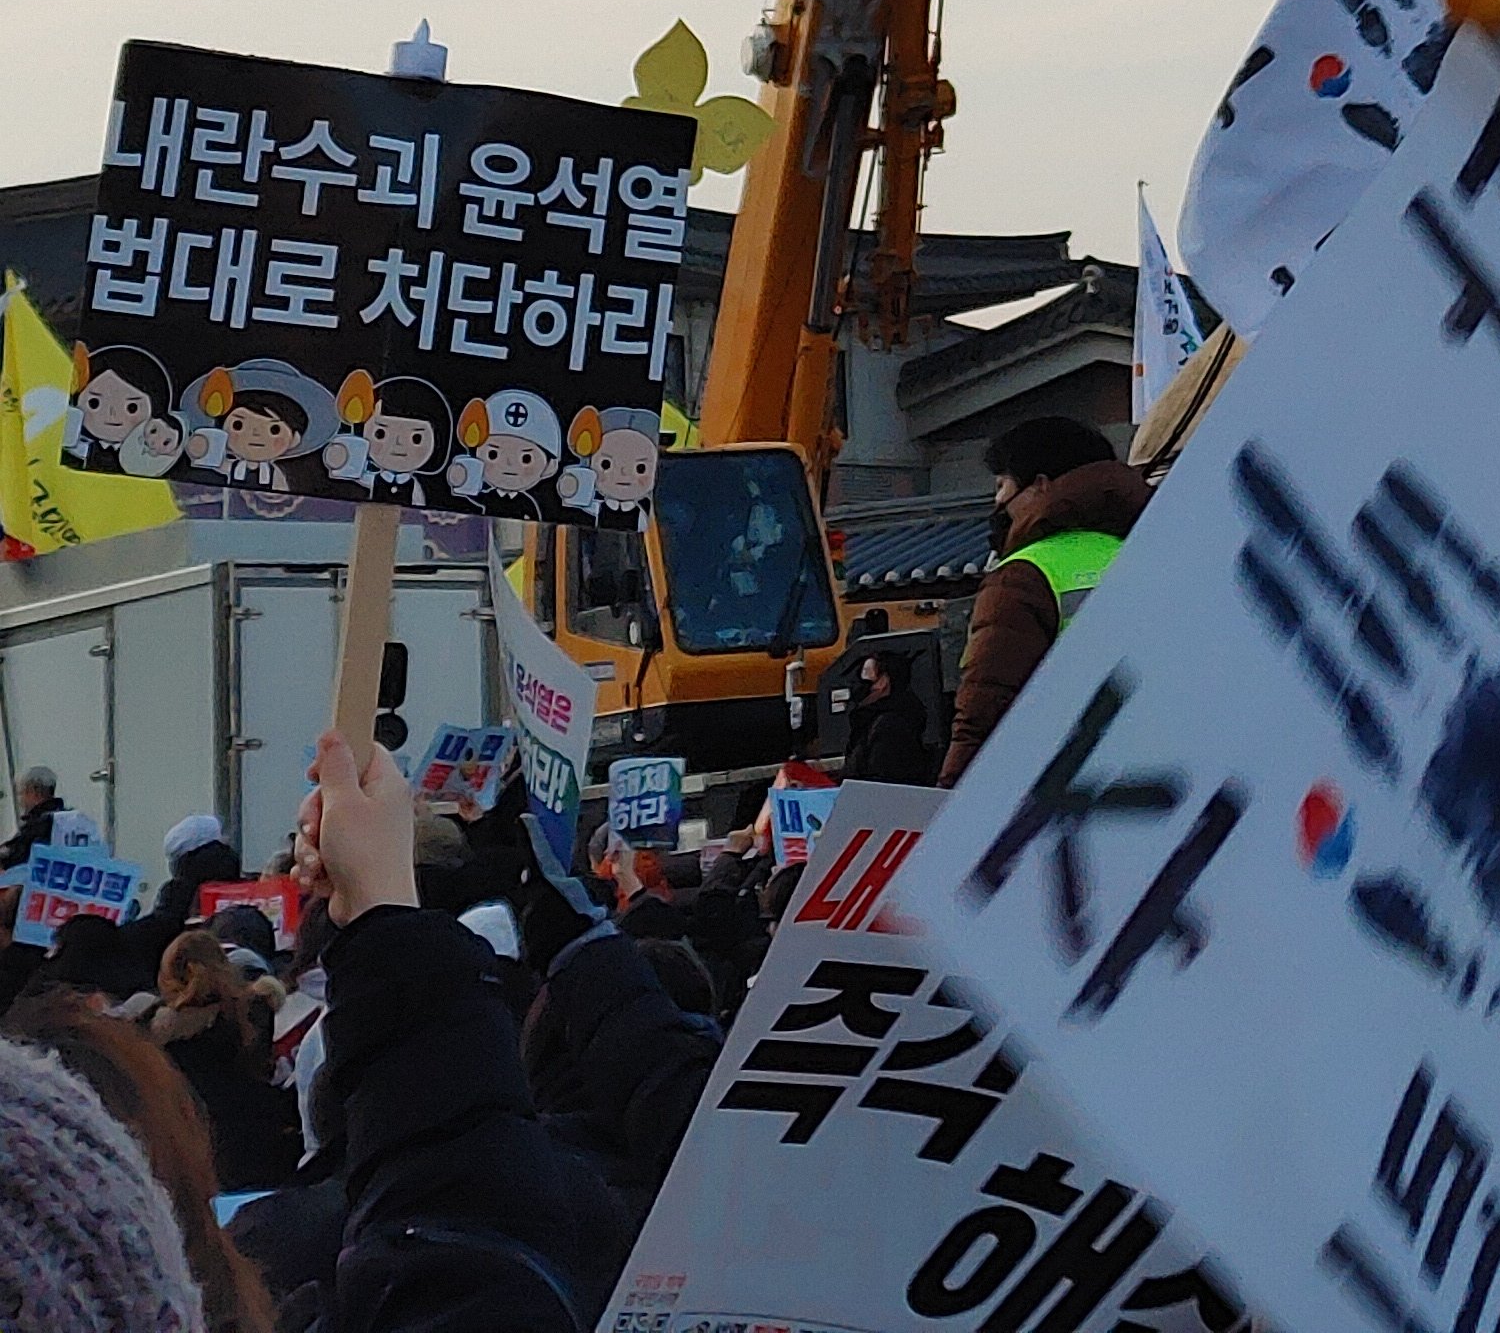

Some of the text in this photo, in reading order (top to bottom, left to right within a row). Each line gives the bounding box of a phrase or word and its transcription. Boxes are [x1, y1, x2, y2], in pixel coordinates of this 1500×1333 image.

[103, 96, 692, 265] 내란수괴 윤석열
[86, 213, 676, 383] 법대로 처단하라
[611, 794, 670, 832] 하라
[717, 958, 1031, 1165] 즉각
